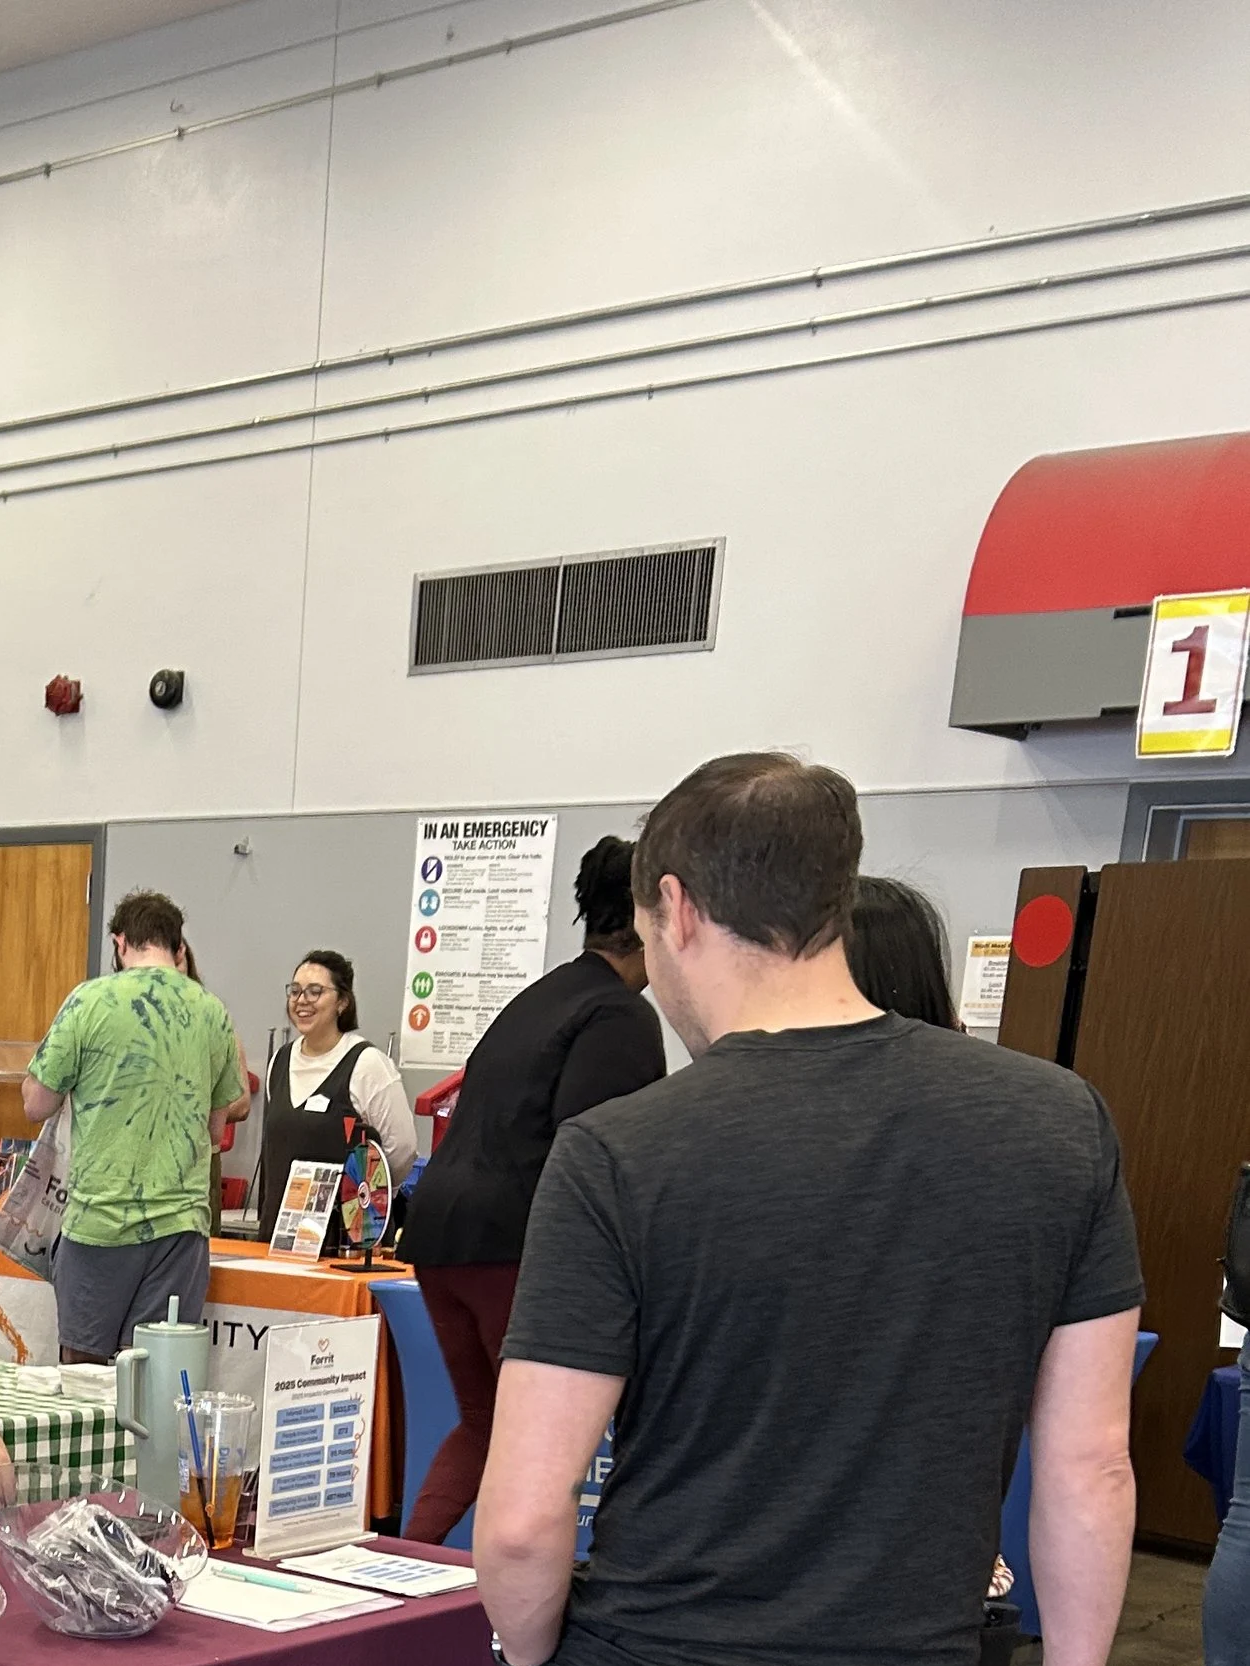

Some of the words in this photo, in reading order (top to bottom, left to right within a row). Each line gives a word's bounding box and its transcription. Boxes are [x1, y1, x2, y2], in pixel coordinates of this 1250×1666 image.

[1162, 625, 1217, 716] 1
[424, 823, 437, 839] IN
[440, 822, 459, 838] AN
[462, 820, 549, 838] EMERGENCY
[452, 840, 476, 850] TAKE
[478, 839, 517, 850] ACTION
[310, 1352, 334, 1365] Forrit
[274, 1381, 296, 1392] 2025
[297, 1373, 340, 1389] Community
[341, 1371, 366, 1383] Impact
